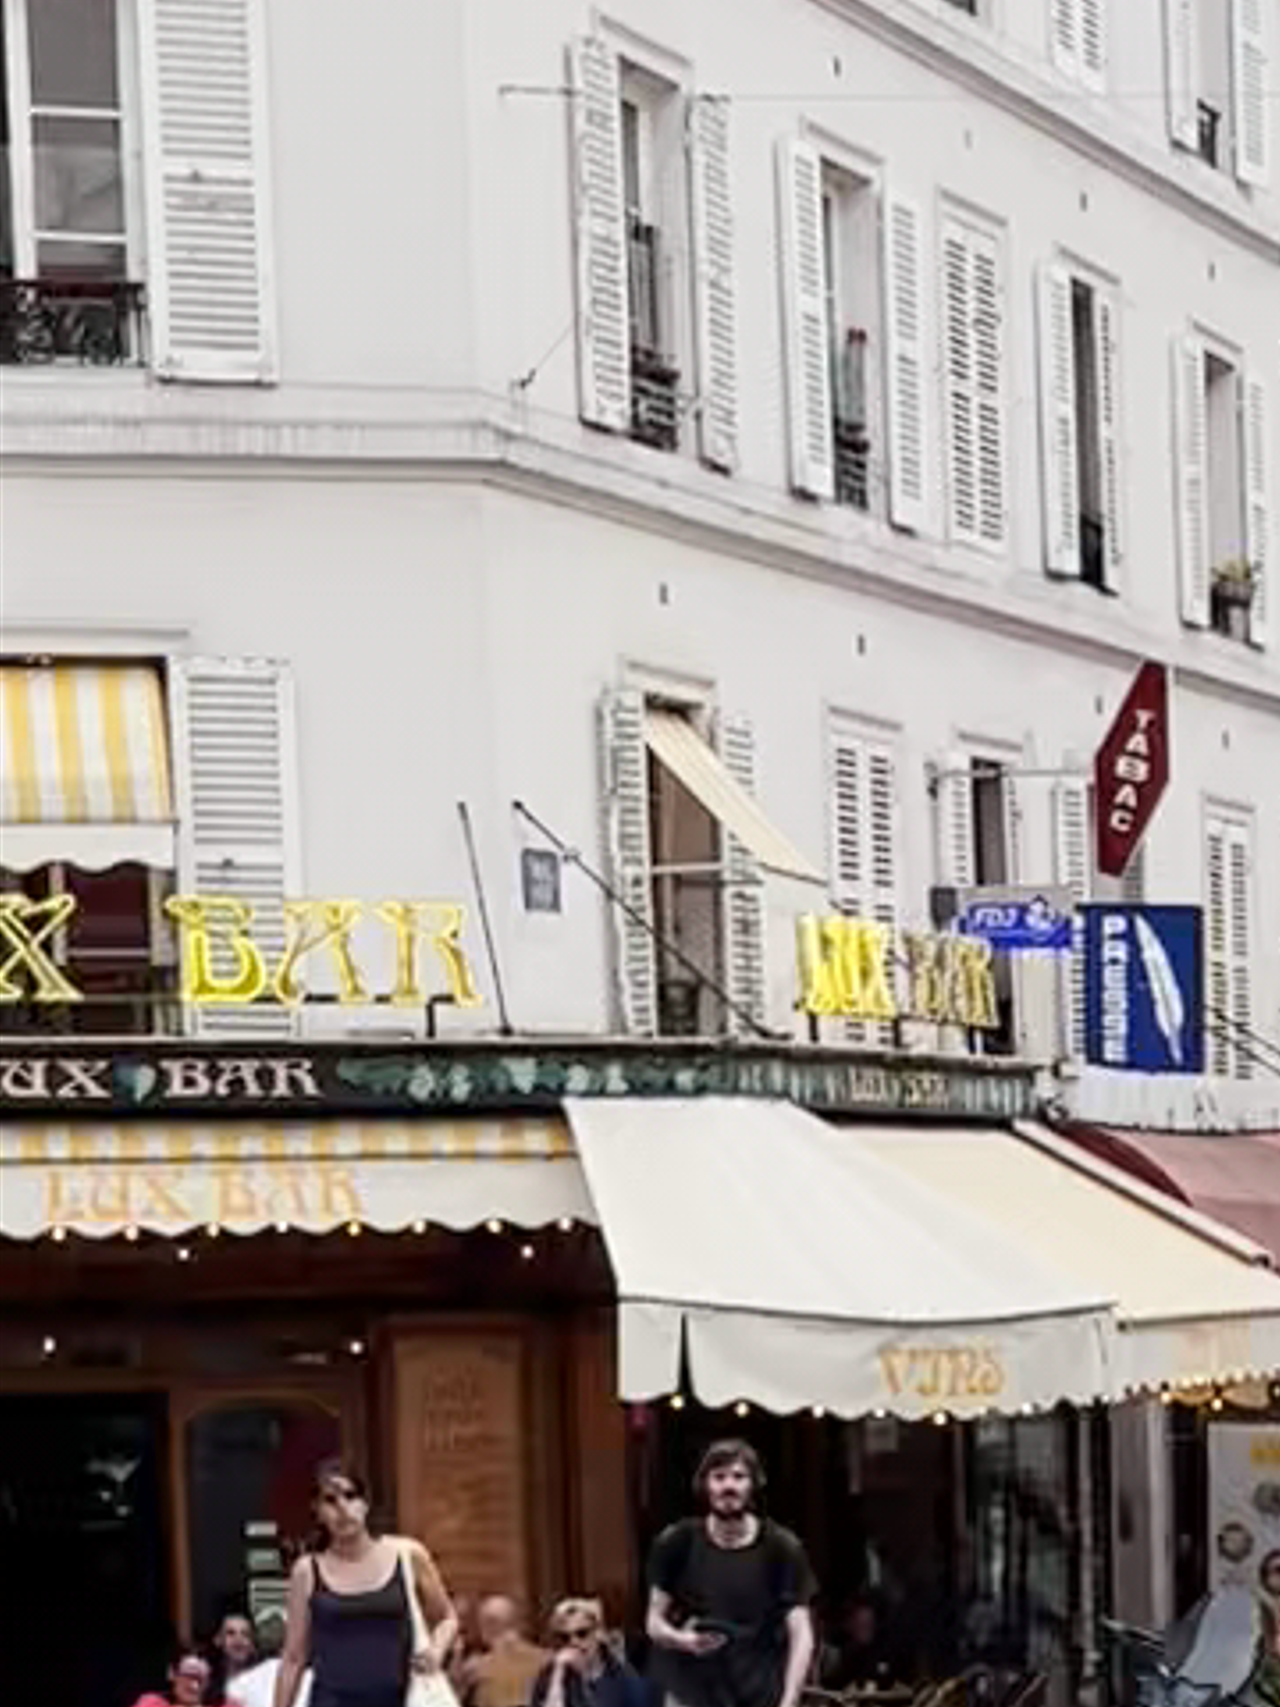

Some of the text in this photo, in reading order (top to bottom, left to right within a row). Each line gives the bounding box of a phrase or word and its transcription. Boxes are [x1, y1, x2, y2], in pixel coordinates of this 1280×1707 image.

[1109, 710, 1156, 832] TABAC
[165, 895, 482, 1007] BAR
[160, 1059, 323, 1097] BAR
[45, 1167, 363, 1223] LUX BAR
